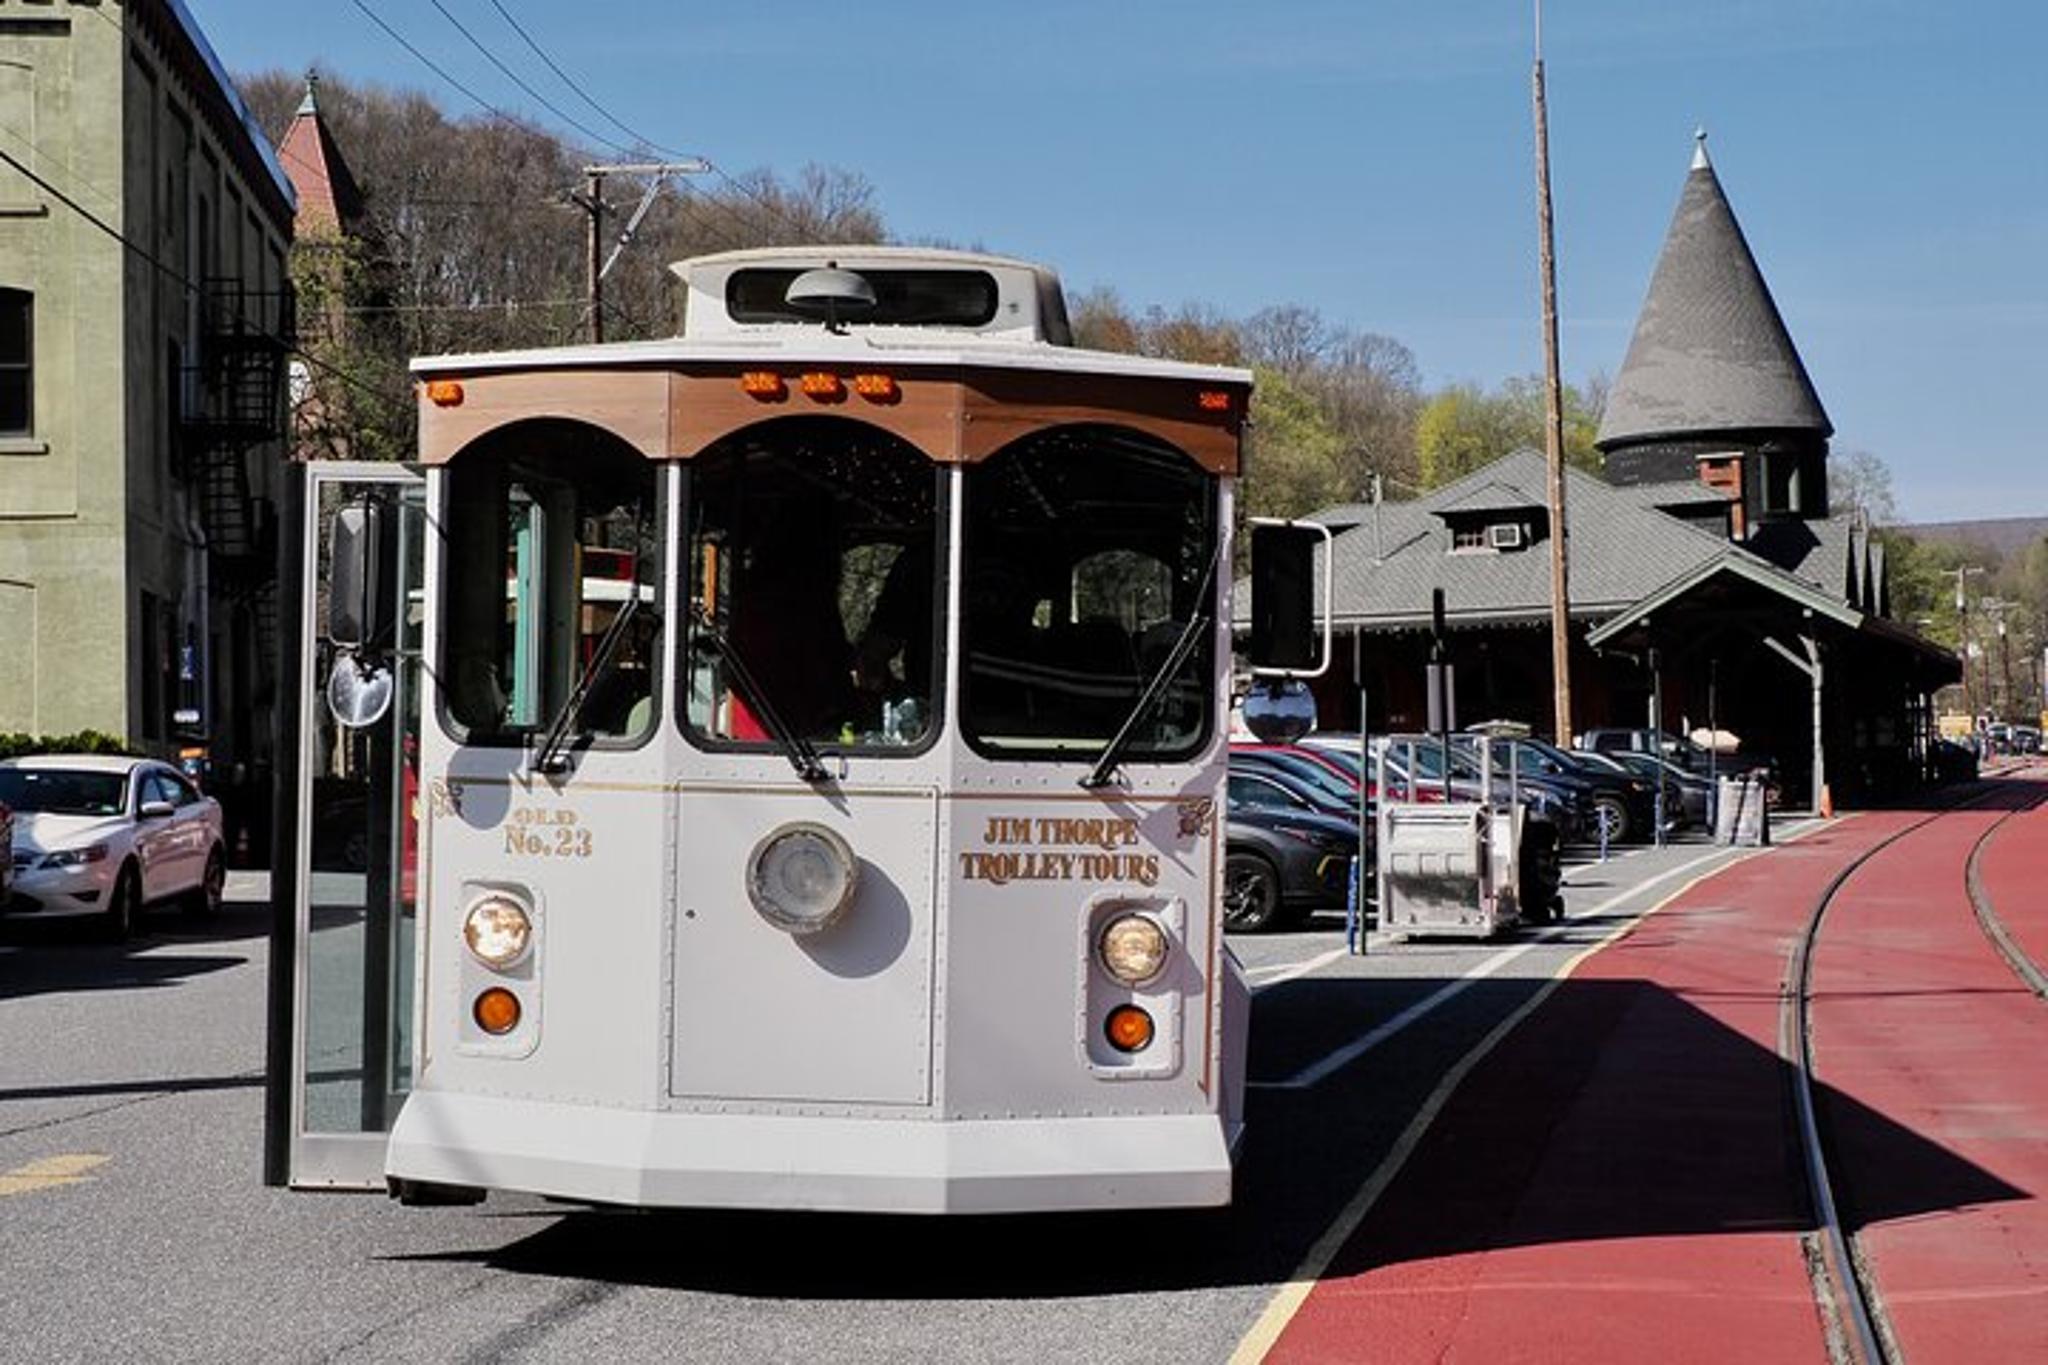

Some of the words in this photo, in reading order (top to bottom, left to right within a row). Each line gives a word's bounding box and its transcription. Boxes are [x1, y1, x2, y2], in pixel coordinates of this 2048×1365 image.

[513, 807, 578, 825] OLD
[984, 817, 1032, 845] JIM
[1036, 817, 1140, 851] THORPE
[959, 852, 1076, 886] TROLLEY
[1077, 852, 1159, 888] TOURS
